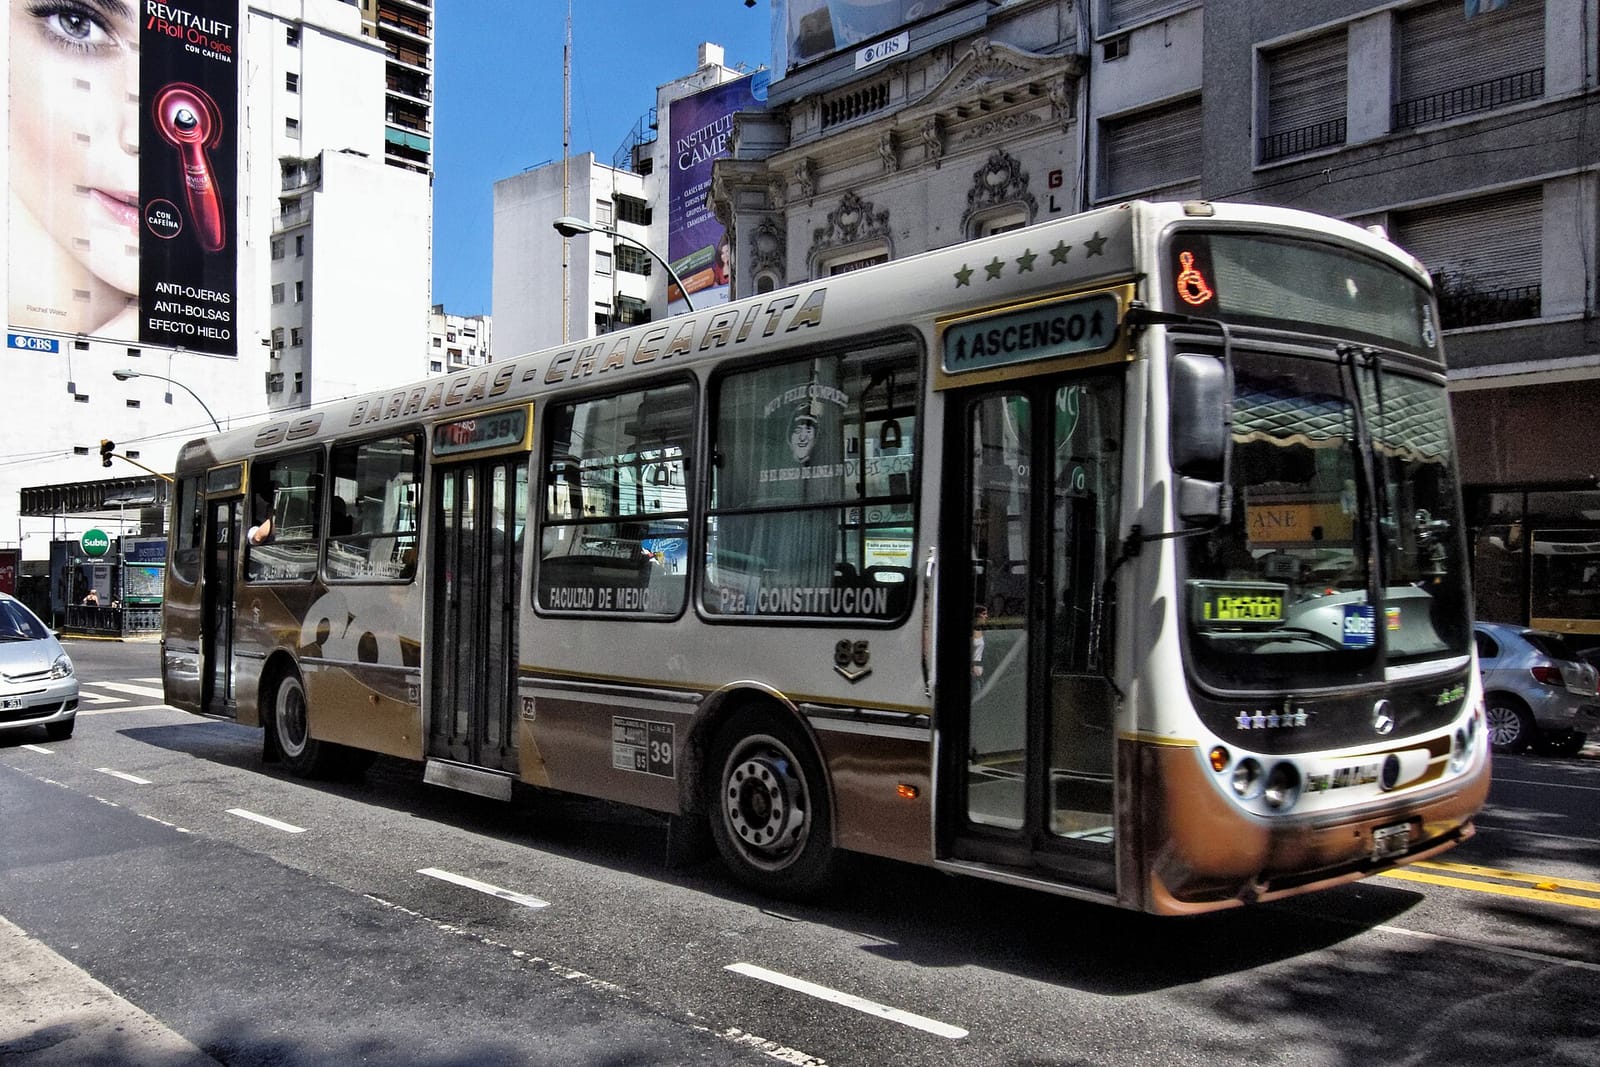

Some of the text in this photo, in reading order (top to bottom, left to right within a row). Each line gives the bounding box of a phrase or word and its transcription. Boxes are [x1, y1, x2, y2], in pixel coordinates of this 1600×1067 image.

[147, 0, 232, 39] REVITALIFT
[157, 19, 231, 54] Roll On ojos
[185, 44, 231, 63] CON CAFEÍNA
[876, 38, 899, 57] CBS
[678, 129, 733, 171] CAMB
[148, 217, 179, 229] CAFEÍNA
[155, 211, 171, 220] CON
[155, 282, 230, 304] ANTI-OJERAS
[154, 301, 230, 322] ANTI-BOLSAS
[149, 319, 231, 340] EFECTO HIELO
[971, 314, 1086, 359] ASCENSO
[27, 338, 52, 350] CBS
[254, 413, 324, 448] 39
[349, 365, 517, 427] BARRACAS
[544, 288, 828, 384] CHACARITA
[84, 538, 108, 547] Subte
[550, 587, 594, 608] FACULTAD
[598, 588, 613, 609] DE
[720, 587, 888, 614] Pza. CONSTITUCION
[1344, 616, 1375, 632] SUBE
[651, 740, 671, 764] 39
